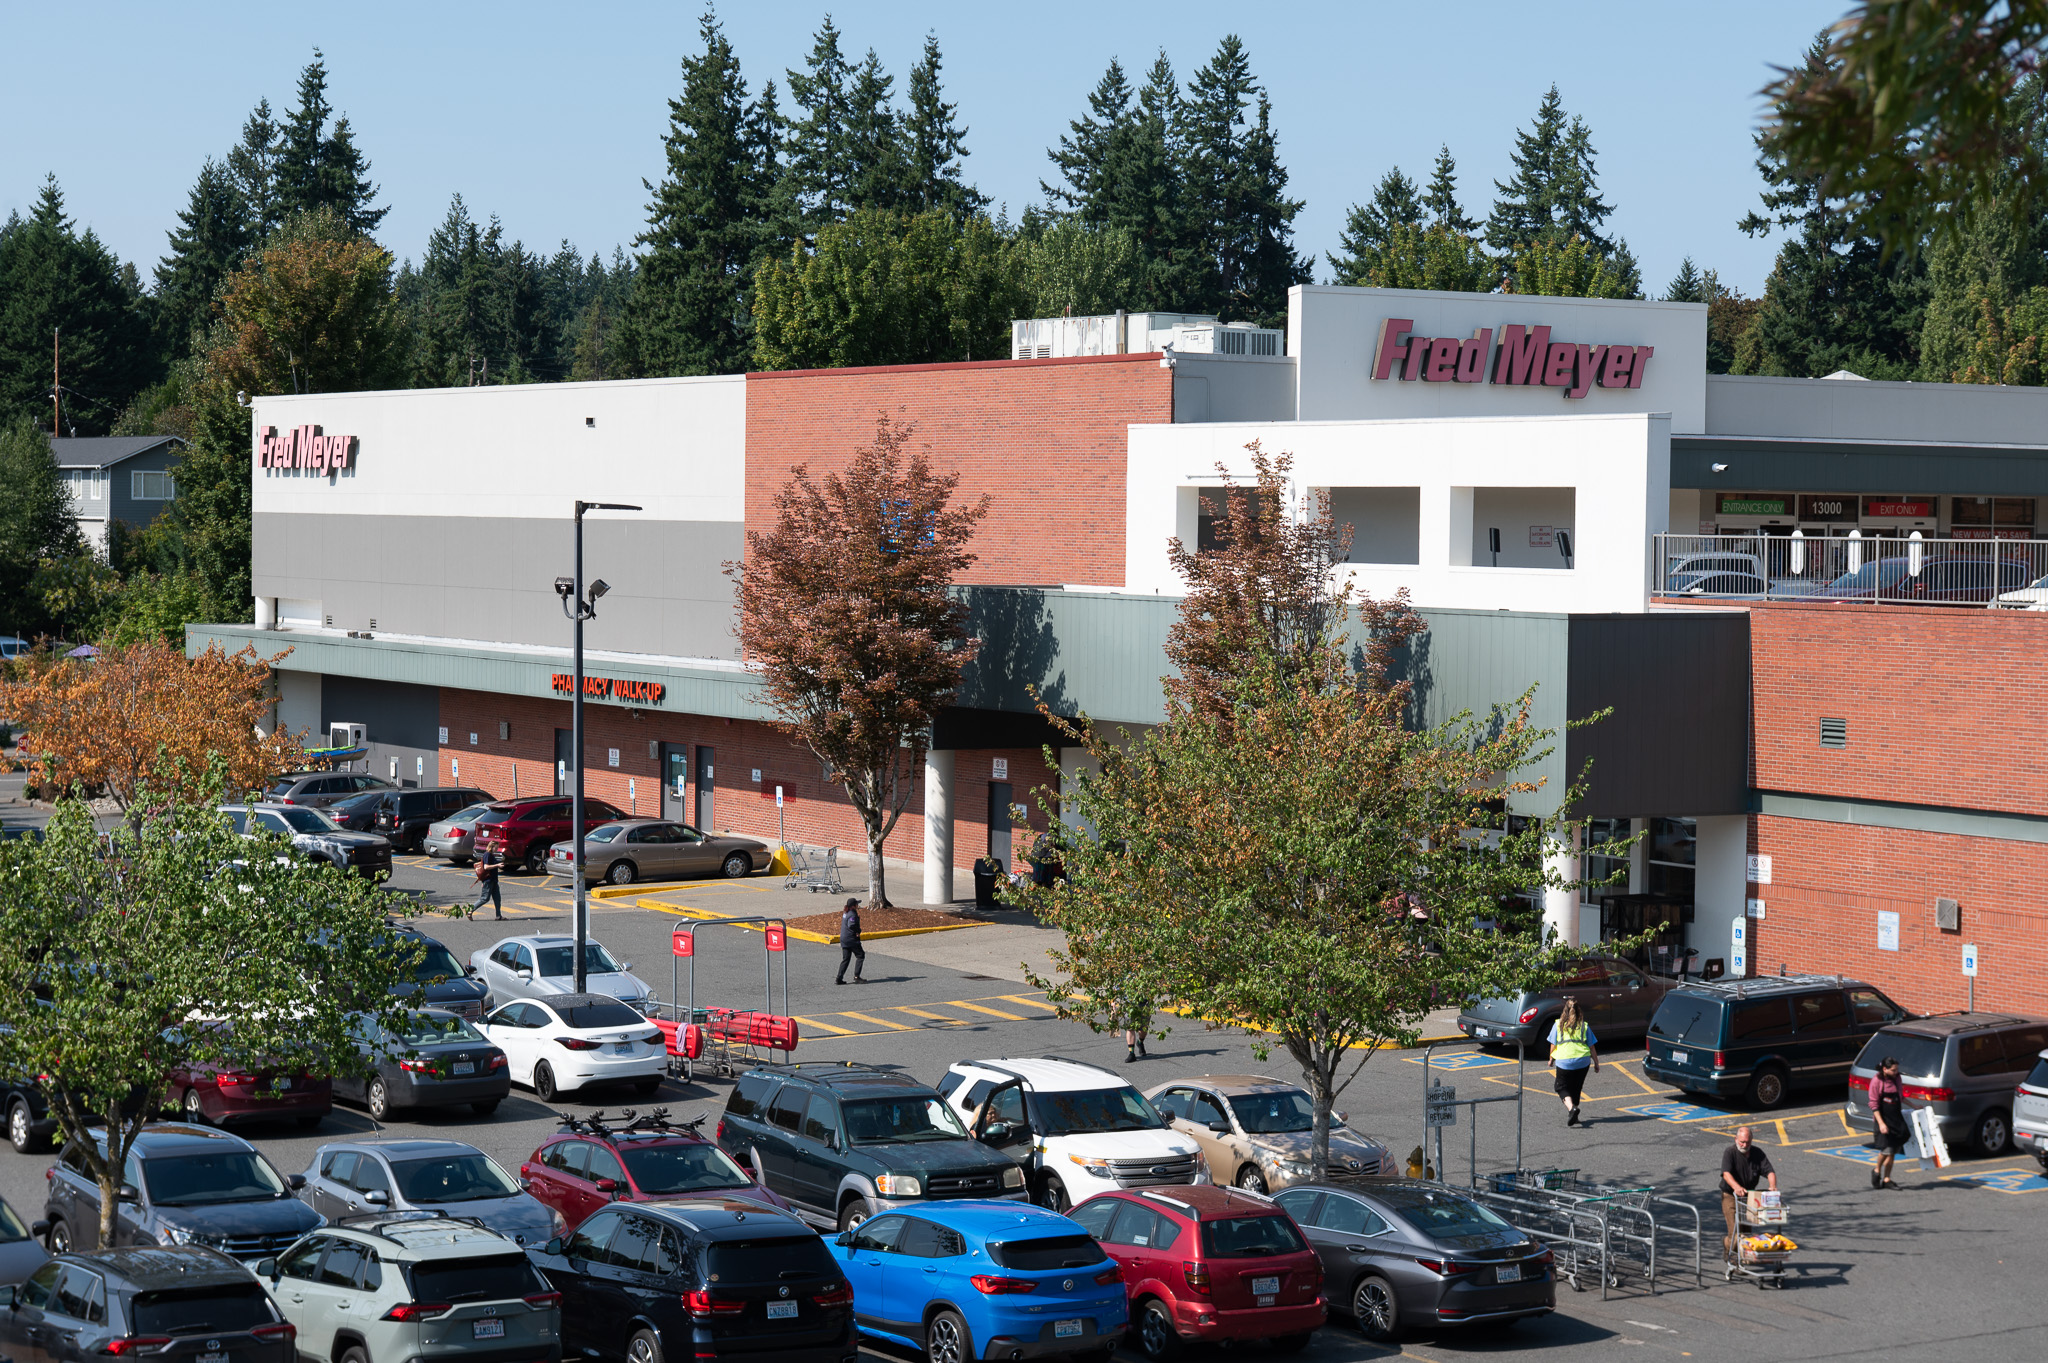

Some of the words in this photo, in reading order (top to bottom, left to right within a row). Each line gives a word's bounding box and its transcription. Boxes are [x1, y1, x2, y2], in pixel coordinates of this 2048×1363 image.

[1373, 318, 1492, 383] Fred
[1491, 324, 1655, 399] Meyer
[258, 425, 295, 469] Fred
[295, 424, 353, 477] Meyer
[1722, 502, 1762, 513] ENTRANCE
[1763, 503, 1784, 513] ONLY
[1812, 501, 1842, 515] 13000
[1880, 505, 1895, 515] EXIT
[1896, 505, 1917, 515] ONLY
[1952, 530, 1972, 539] NEW
[2009, 531, 2030, 540] SAVE
[612, 679, 662, 701] WALK-UP
